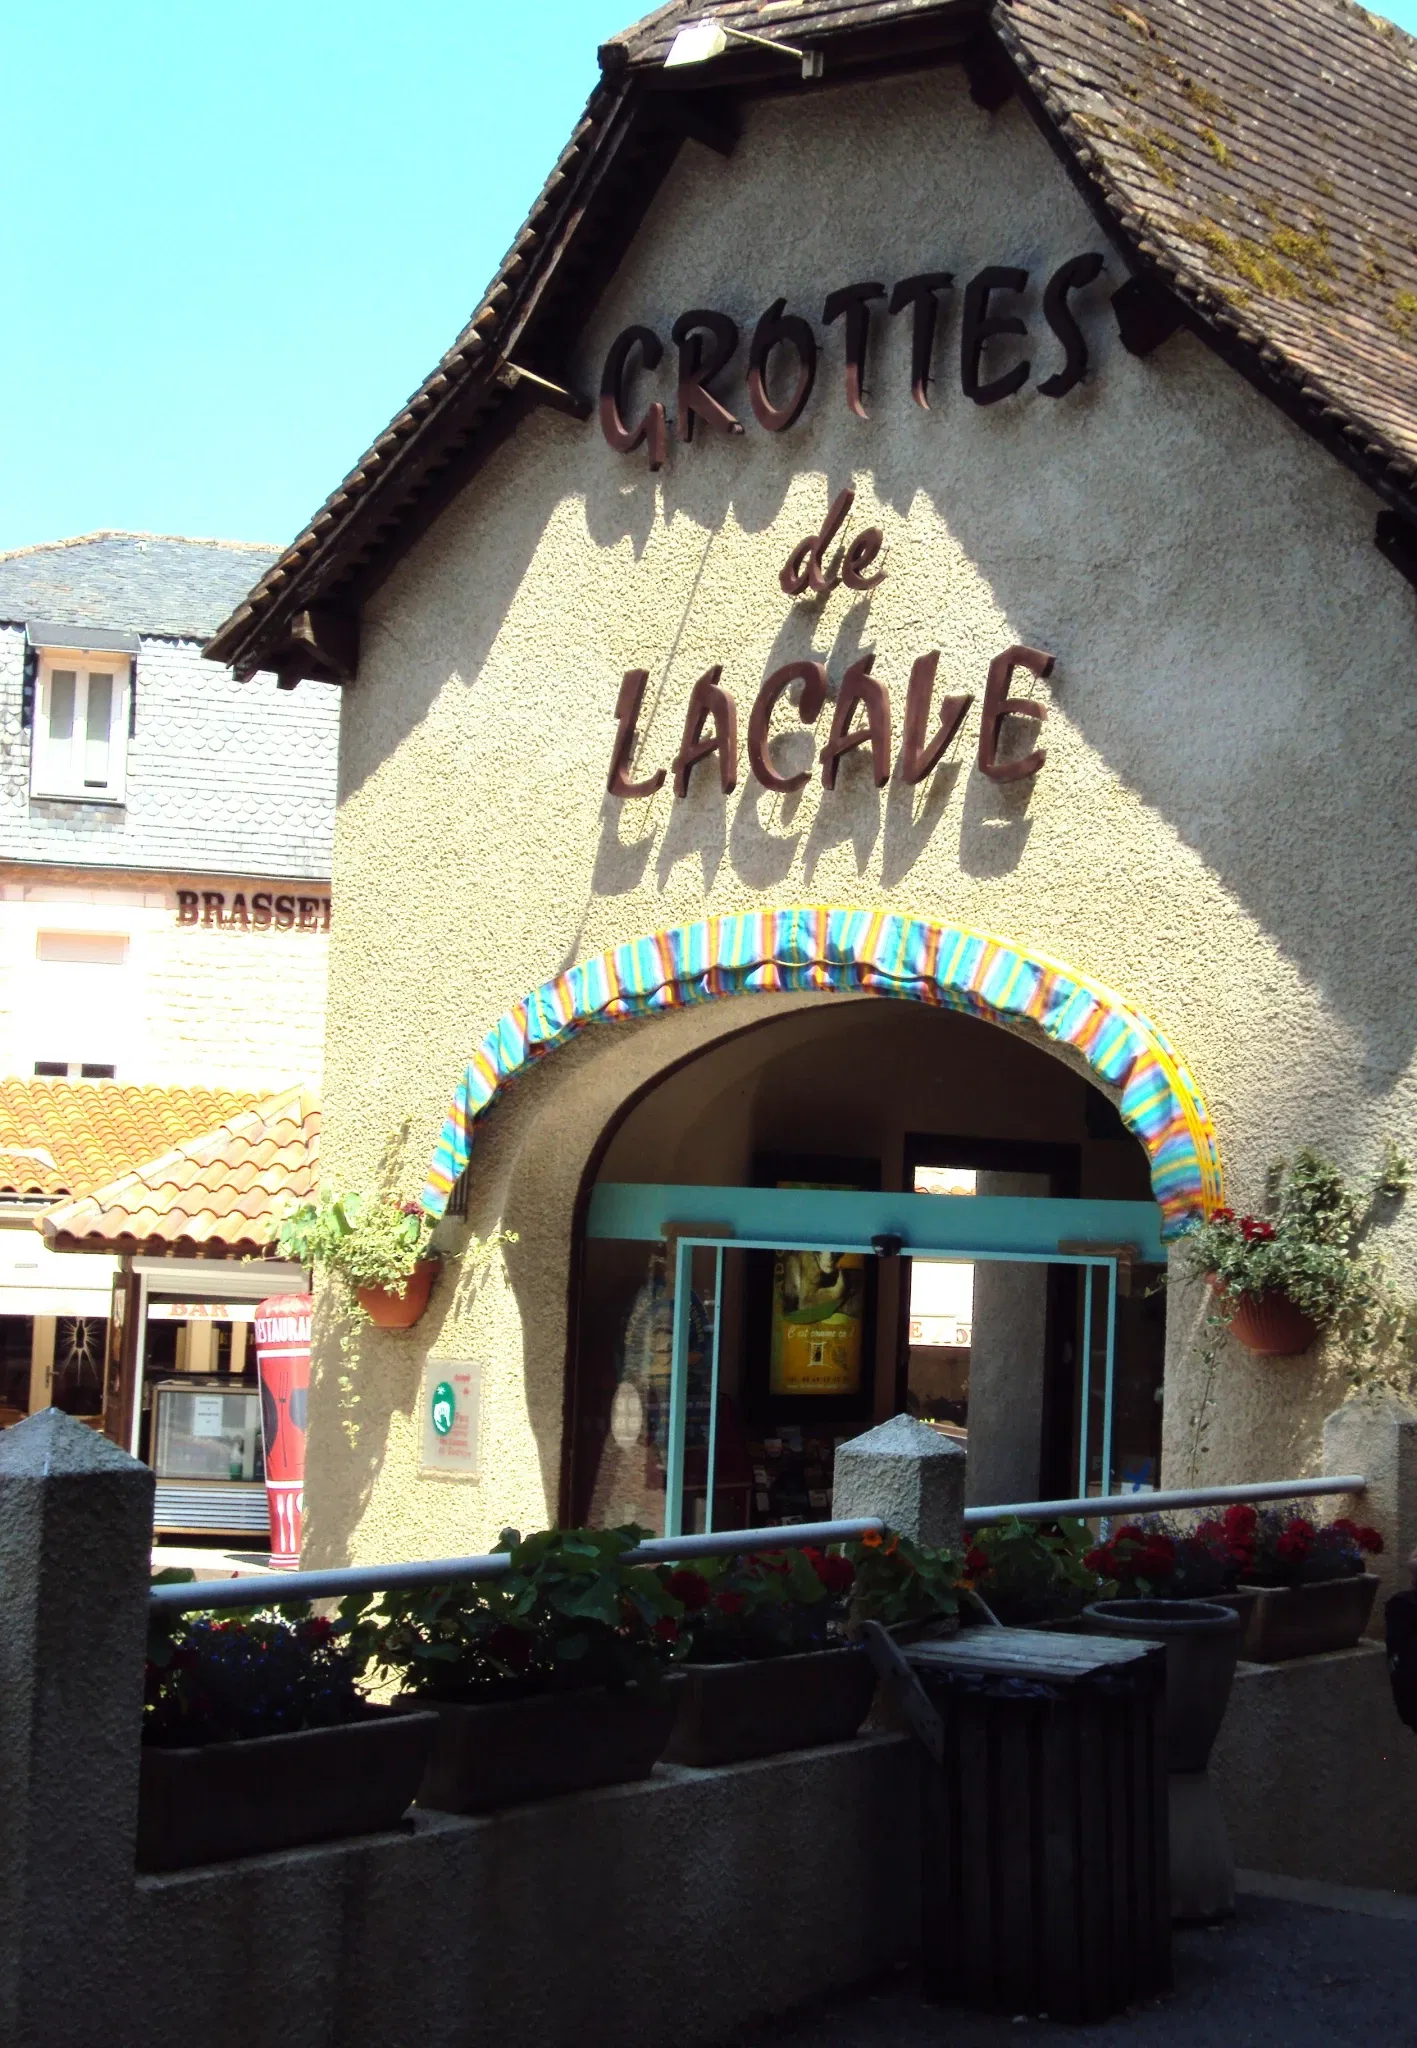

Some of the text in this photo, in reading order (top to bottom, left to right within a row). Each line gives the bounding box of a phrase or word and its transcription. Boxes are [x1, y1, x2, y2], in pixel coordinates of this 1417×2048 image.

[600, 252, 1105, 472] GROTTES
[779, 487, 888, 596] de
[606, 644, 1056, 798] LACAVE
[169, 1303, 229, 1318] BAR
